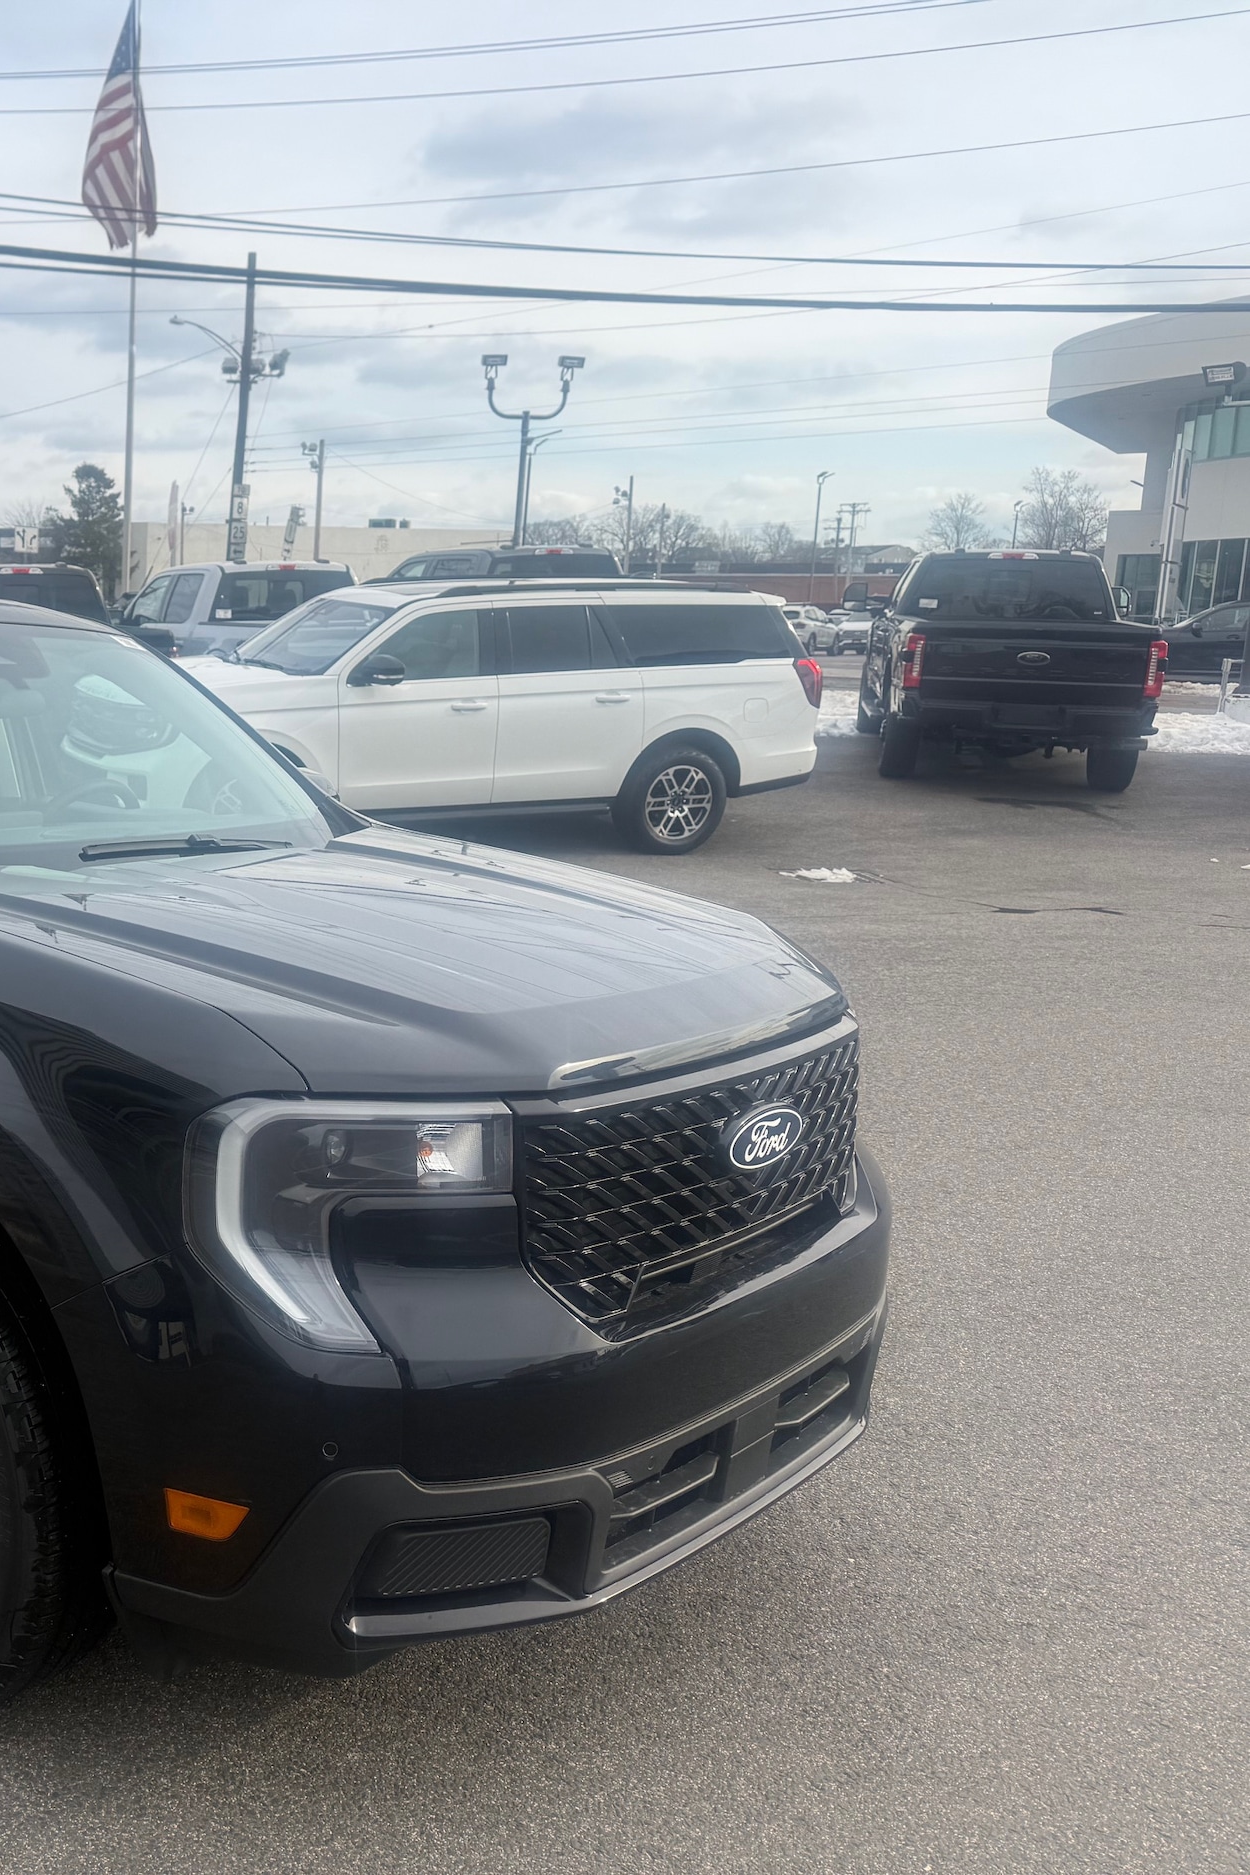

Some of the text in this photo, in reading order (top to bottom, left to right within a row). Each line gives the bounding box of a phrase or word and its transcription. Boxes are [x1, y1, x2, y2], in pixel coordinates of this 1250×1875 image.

[237, 502, 244, 514] 8
[232, 526, 245, 539] 25
[744, 1117, 792, 1163] Ford
